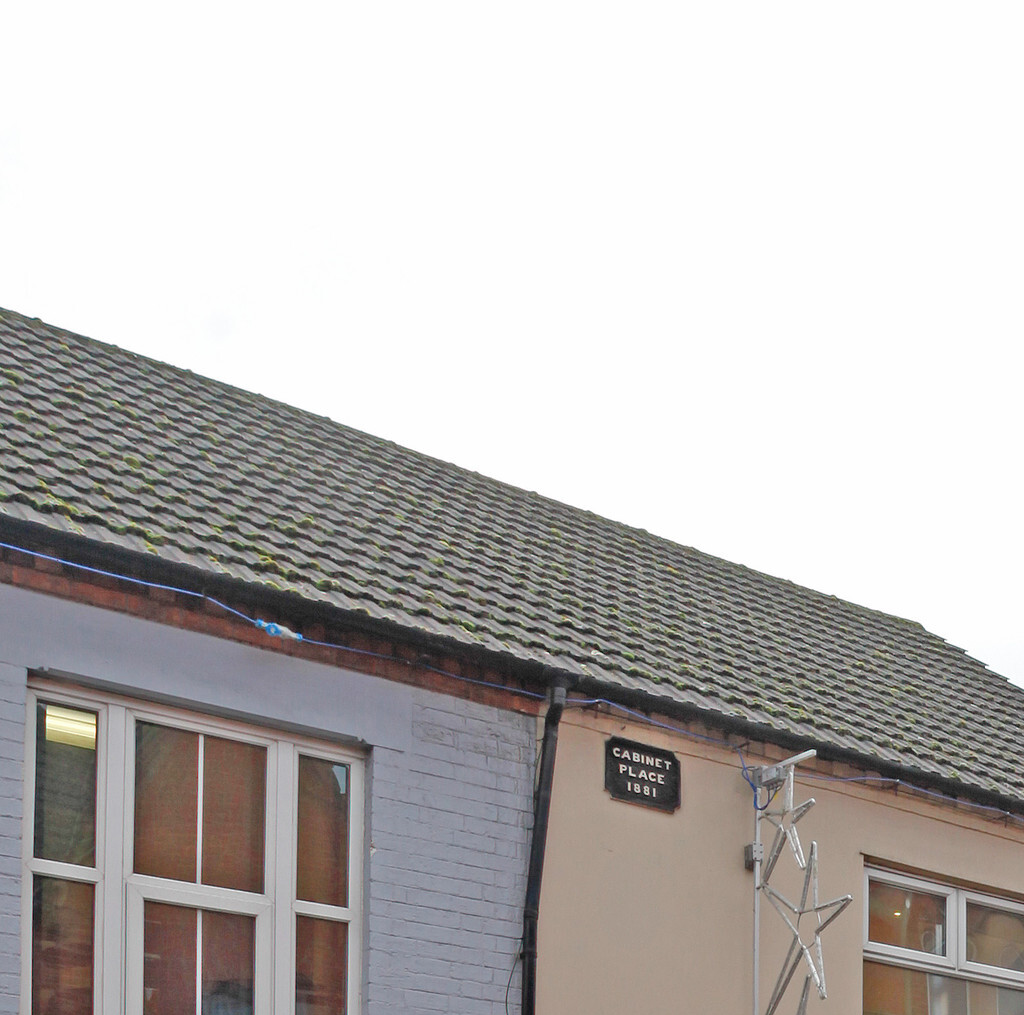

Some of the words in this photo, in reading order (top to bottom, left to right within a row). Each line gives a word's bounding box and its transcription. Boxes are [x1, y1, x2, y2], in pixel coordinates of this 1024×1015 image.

[612, 747, 672, 771] CABINET
[619, 764, 665, 785] PLACE
[627, 782, 656, 798] 1881
